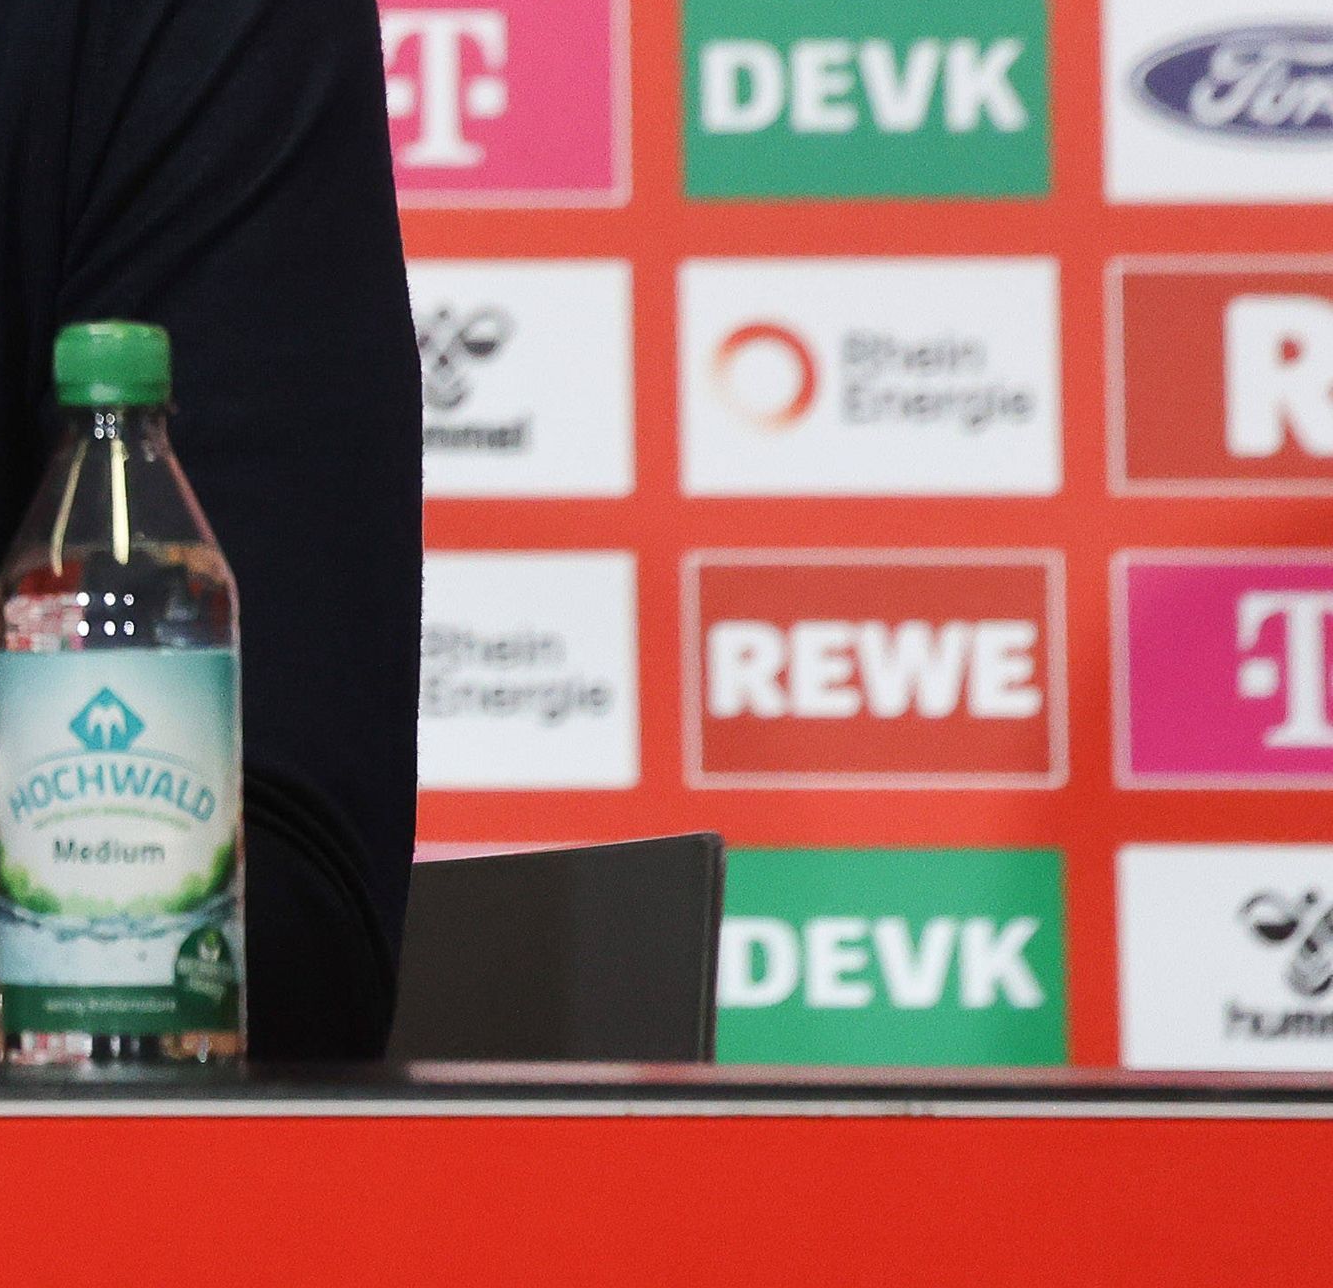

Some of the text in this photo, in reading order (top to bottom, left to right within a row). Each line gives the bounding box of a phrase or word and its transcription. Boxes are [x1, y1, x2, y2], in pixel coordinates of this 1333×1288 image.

[701, 39, 1026, 133] DEVK
[707, 621, 1041, 718] REWE
[9, 764, 217, 824] HOCHWALD
[52, 838, 166, 864] Medium
[719, 912, 1048, 1012] DEVK
